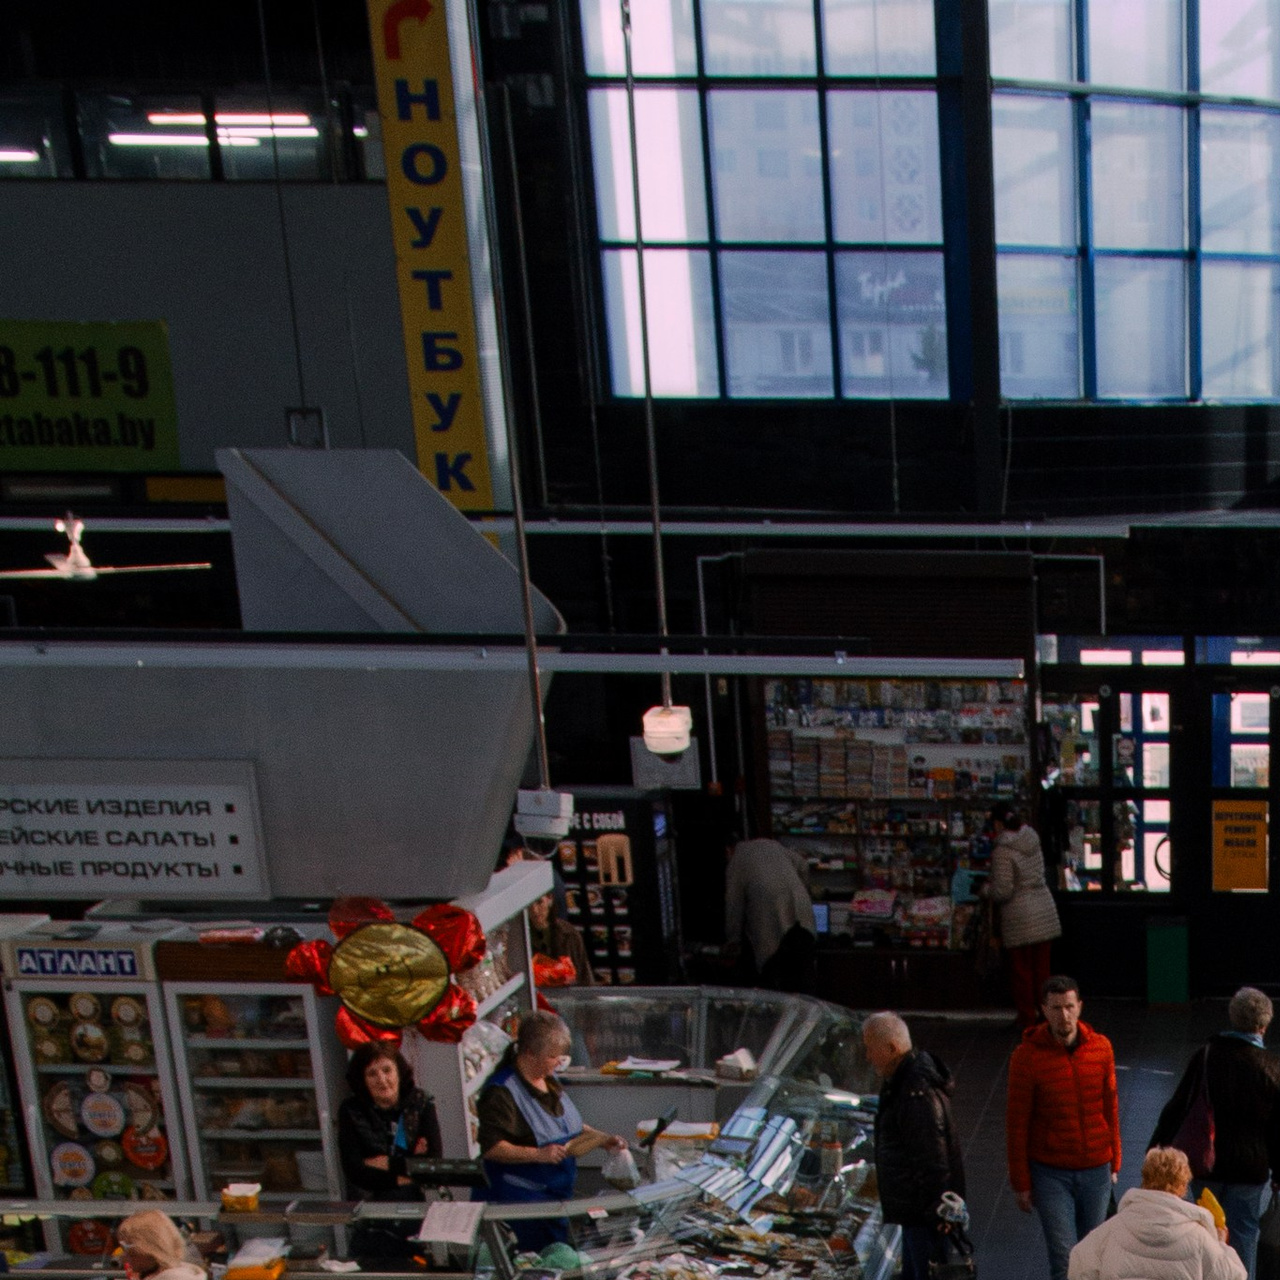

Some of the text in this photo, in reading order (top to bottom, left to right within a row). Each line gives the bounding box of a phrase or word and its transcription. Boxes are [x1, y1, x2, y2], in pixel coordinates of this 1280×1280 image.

[395, 79, 476, 493] НОУТБУК
[0, 411, 156, 450] tabaka.by
[86, 799, 211, 818] ИЗДЕЛИЯ
[106, 830, 215, 846] САЛАТЫ
[0, 861, 219, 880] ЧНЫЕ ПРОДУКТЫ
[18, 949, 137, 976] АТЛАНТ
